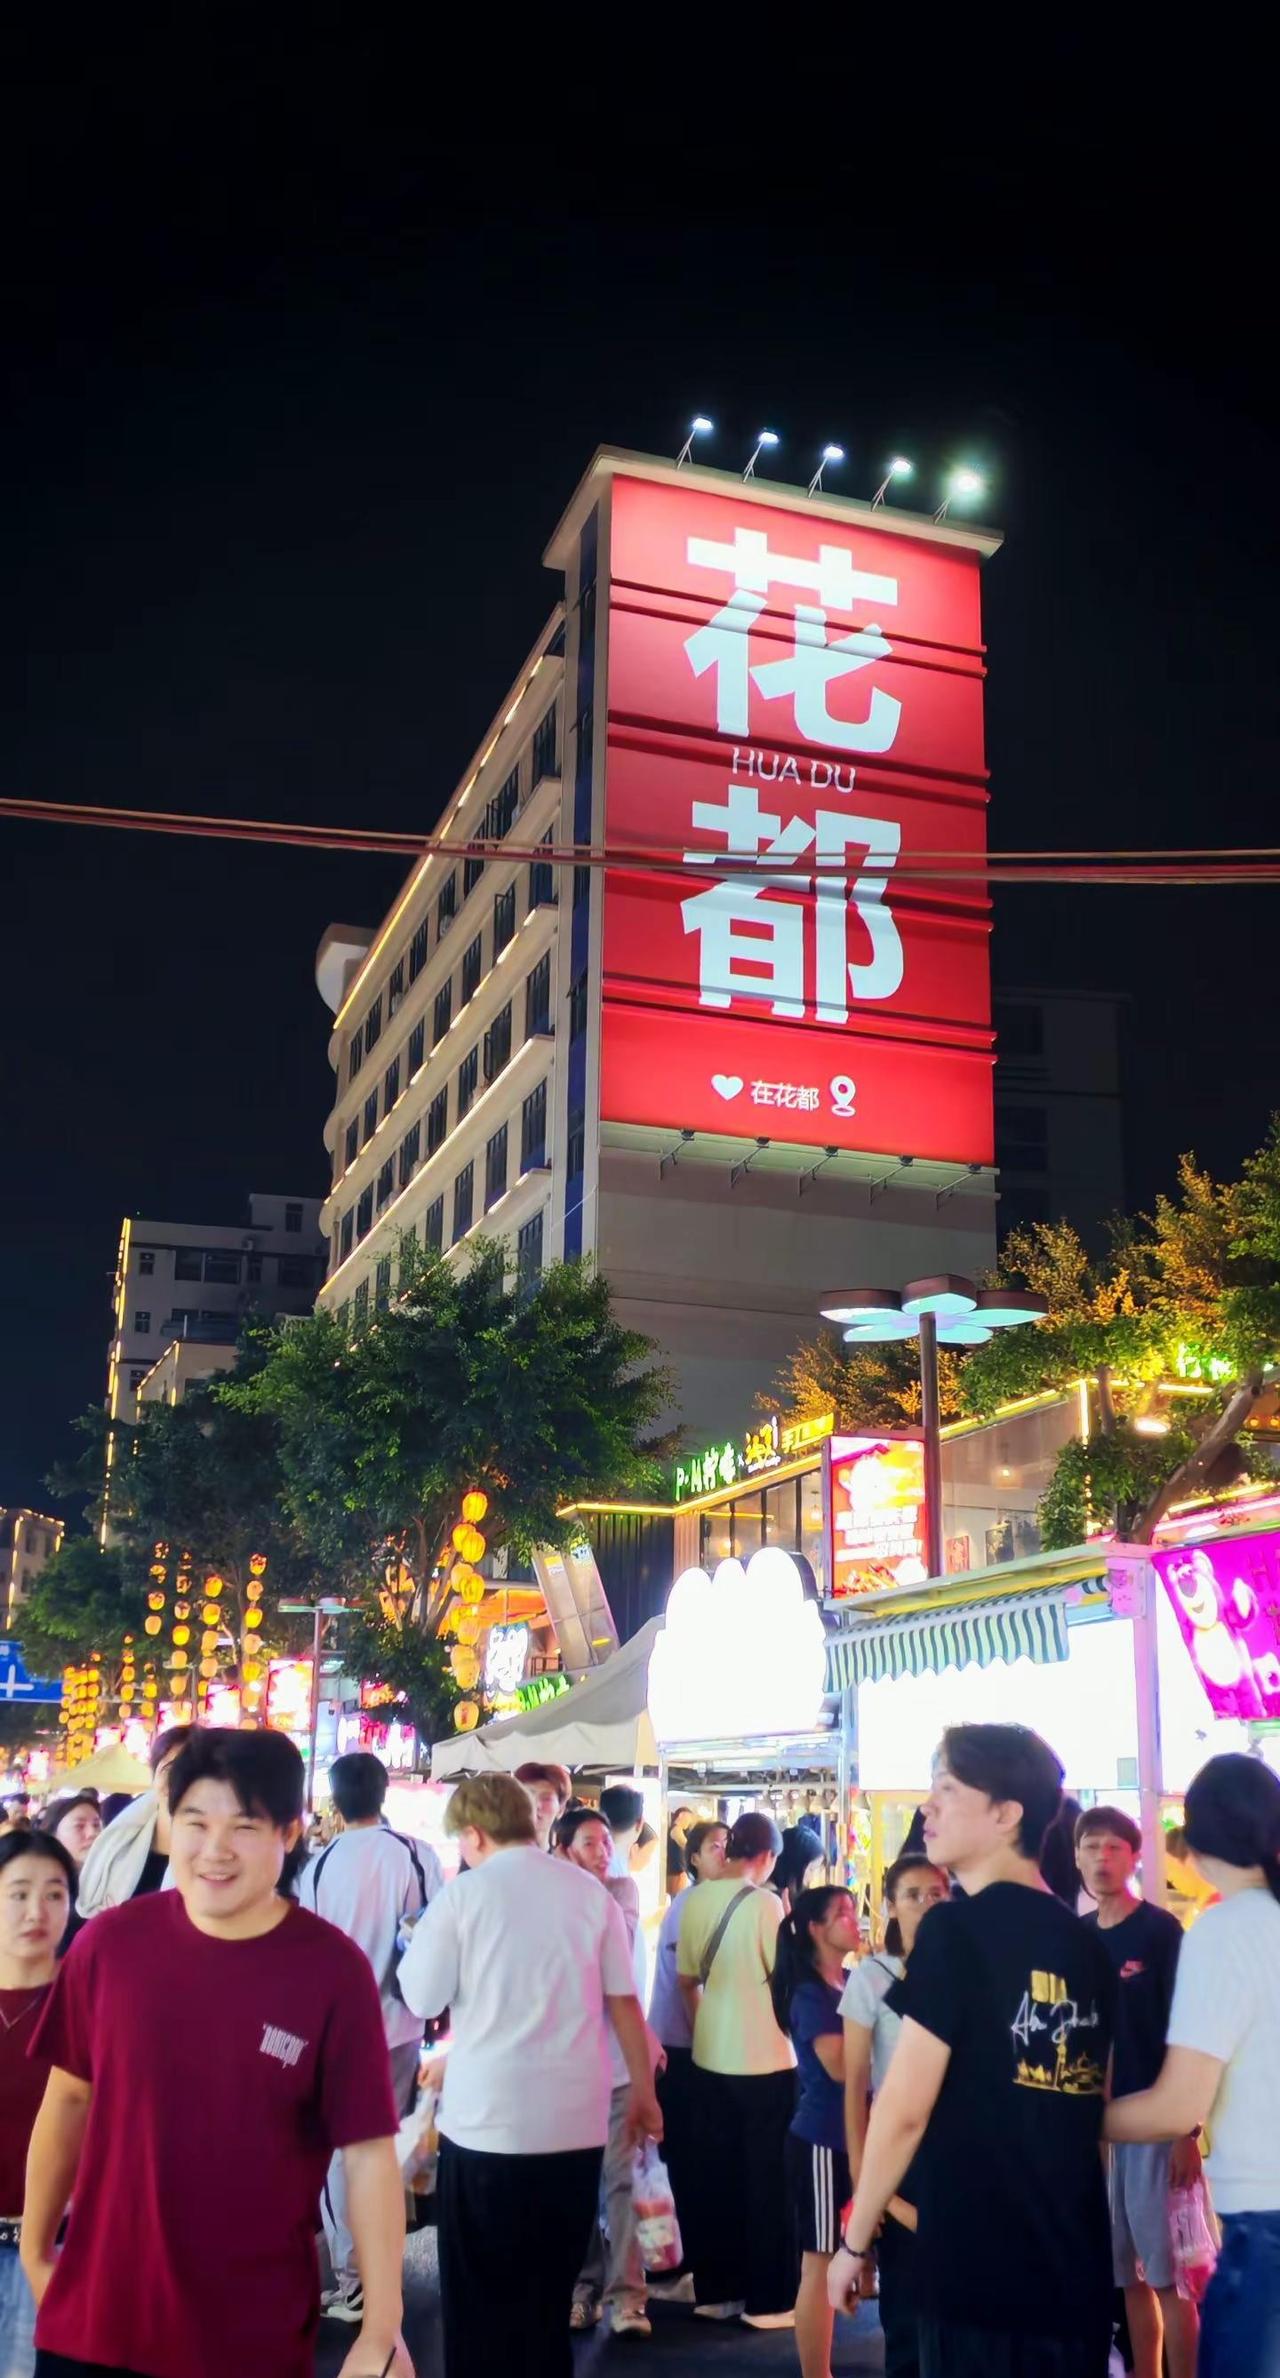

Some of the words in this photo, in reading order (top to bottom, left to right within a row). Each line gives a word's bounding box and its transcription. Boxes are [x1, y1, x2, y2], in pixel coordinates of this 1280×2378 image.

[683, 527, 901, 753] 花
[732, 747, 801, 785] HUA
[811, 760, 856, 793] DU
[680, 784, 904, 1023] 都
[750, 1080, 820, 1112] 在花都
